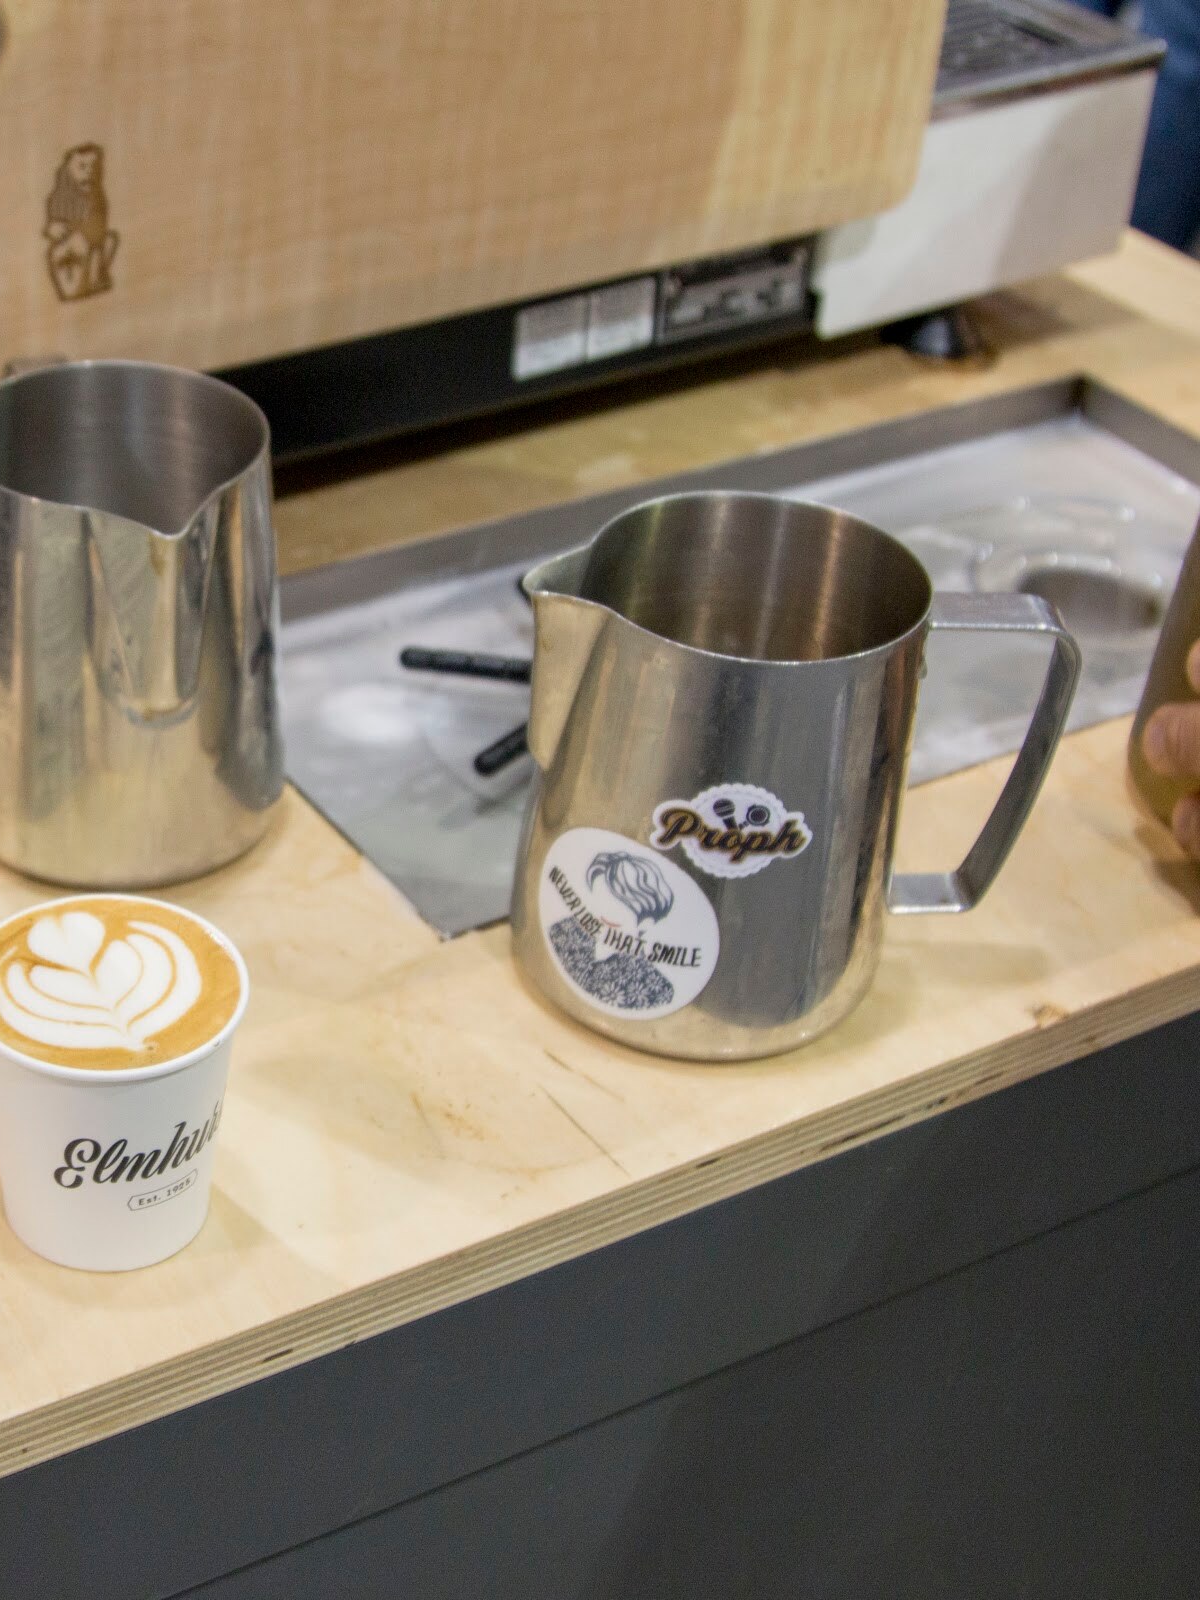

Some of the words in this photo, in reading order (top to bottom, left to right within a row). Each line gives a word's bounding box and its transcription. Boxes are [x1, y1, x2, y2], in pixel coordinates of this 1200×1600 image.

[657, 806, 806, 864] Proph
[548, 865, 582, 912] NEVER
[573, 906, 605, 937] LOSE
[603, 927, 648, 957] THAT
[647, 942, 703, 968] SMILE
[138, 1195, 161, 1207] Est.
